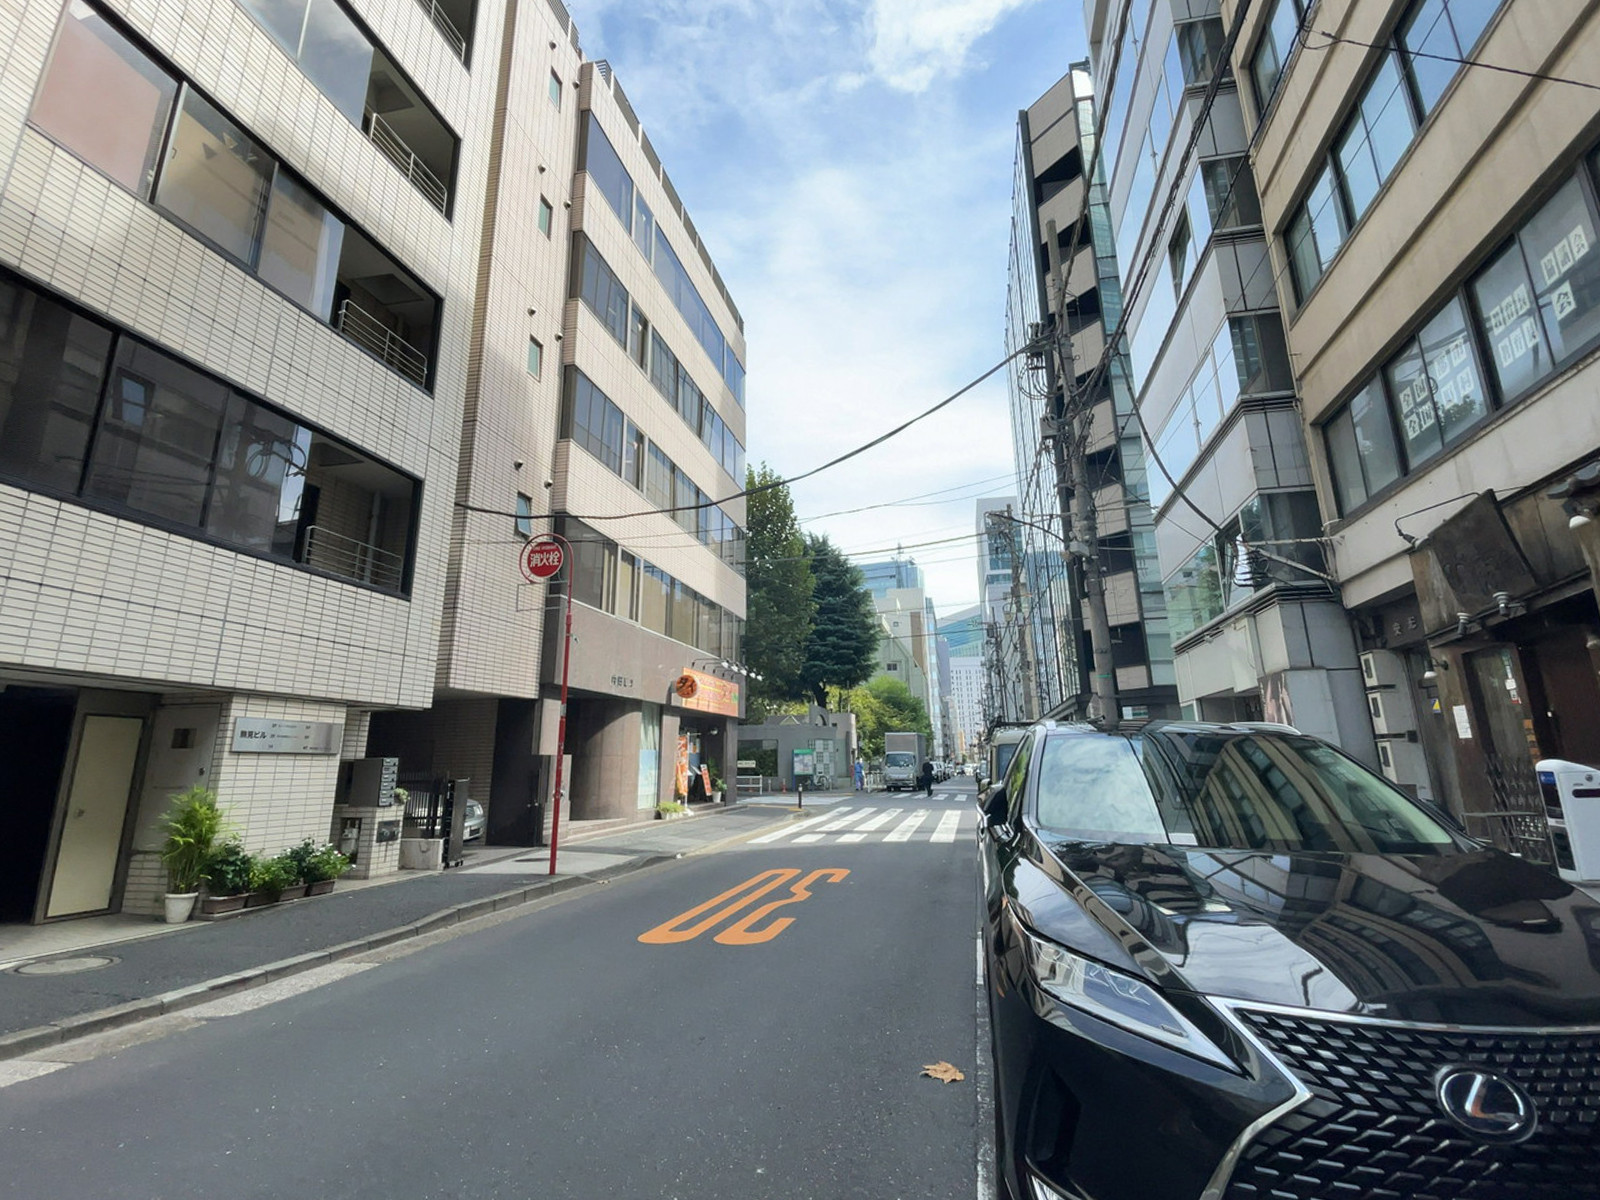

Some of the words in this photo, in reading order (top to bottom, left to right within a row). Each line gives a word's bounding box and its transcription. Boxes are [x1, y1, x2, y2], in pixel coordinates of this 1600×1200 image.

[530, 550, 560, 567] 消火栓
[637, 868, 851, 945] 30
